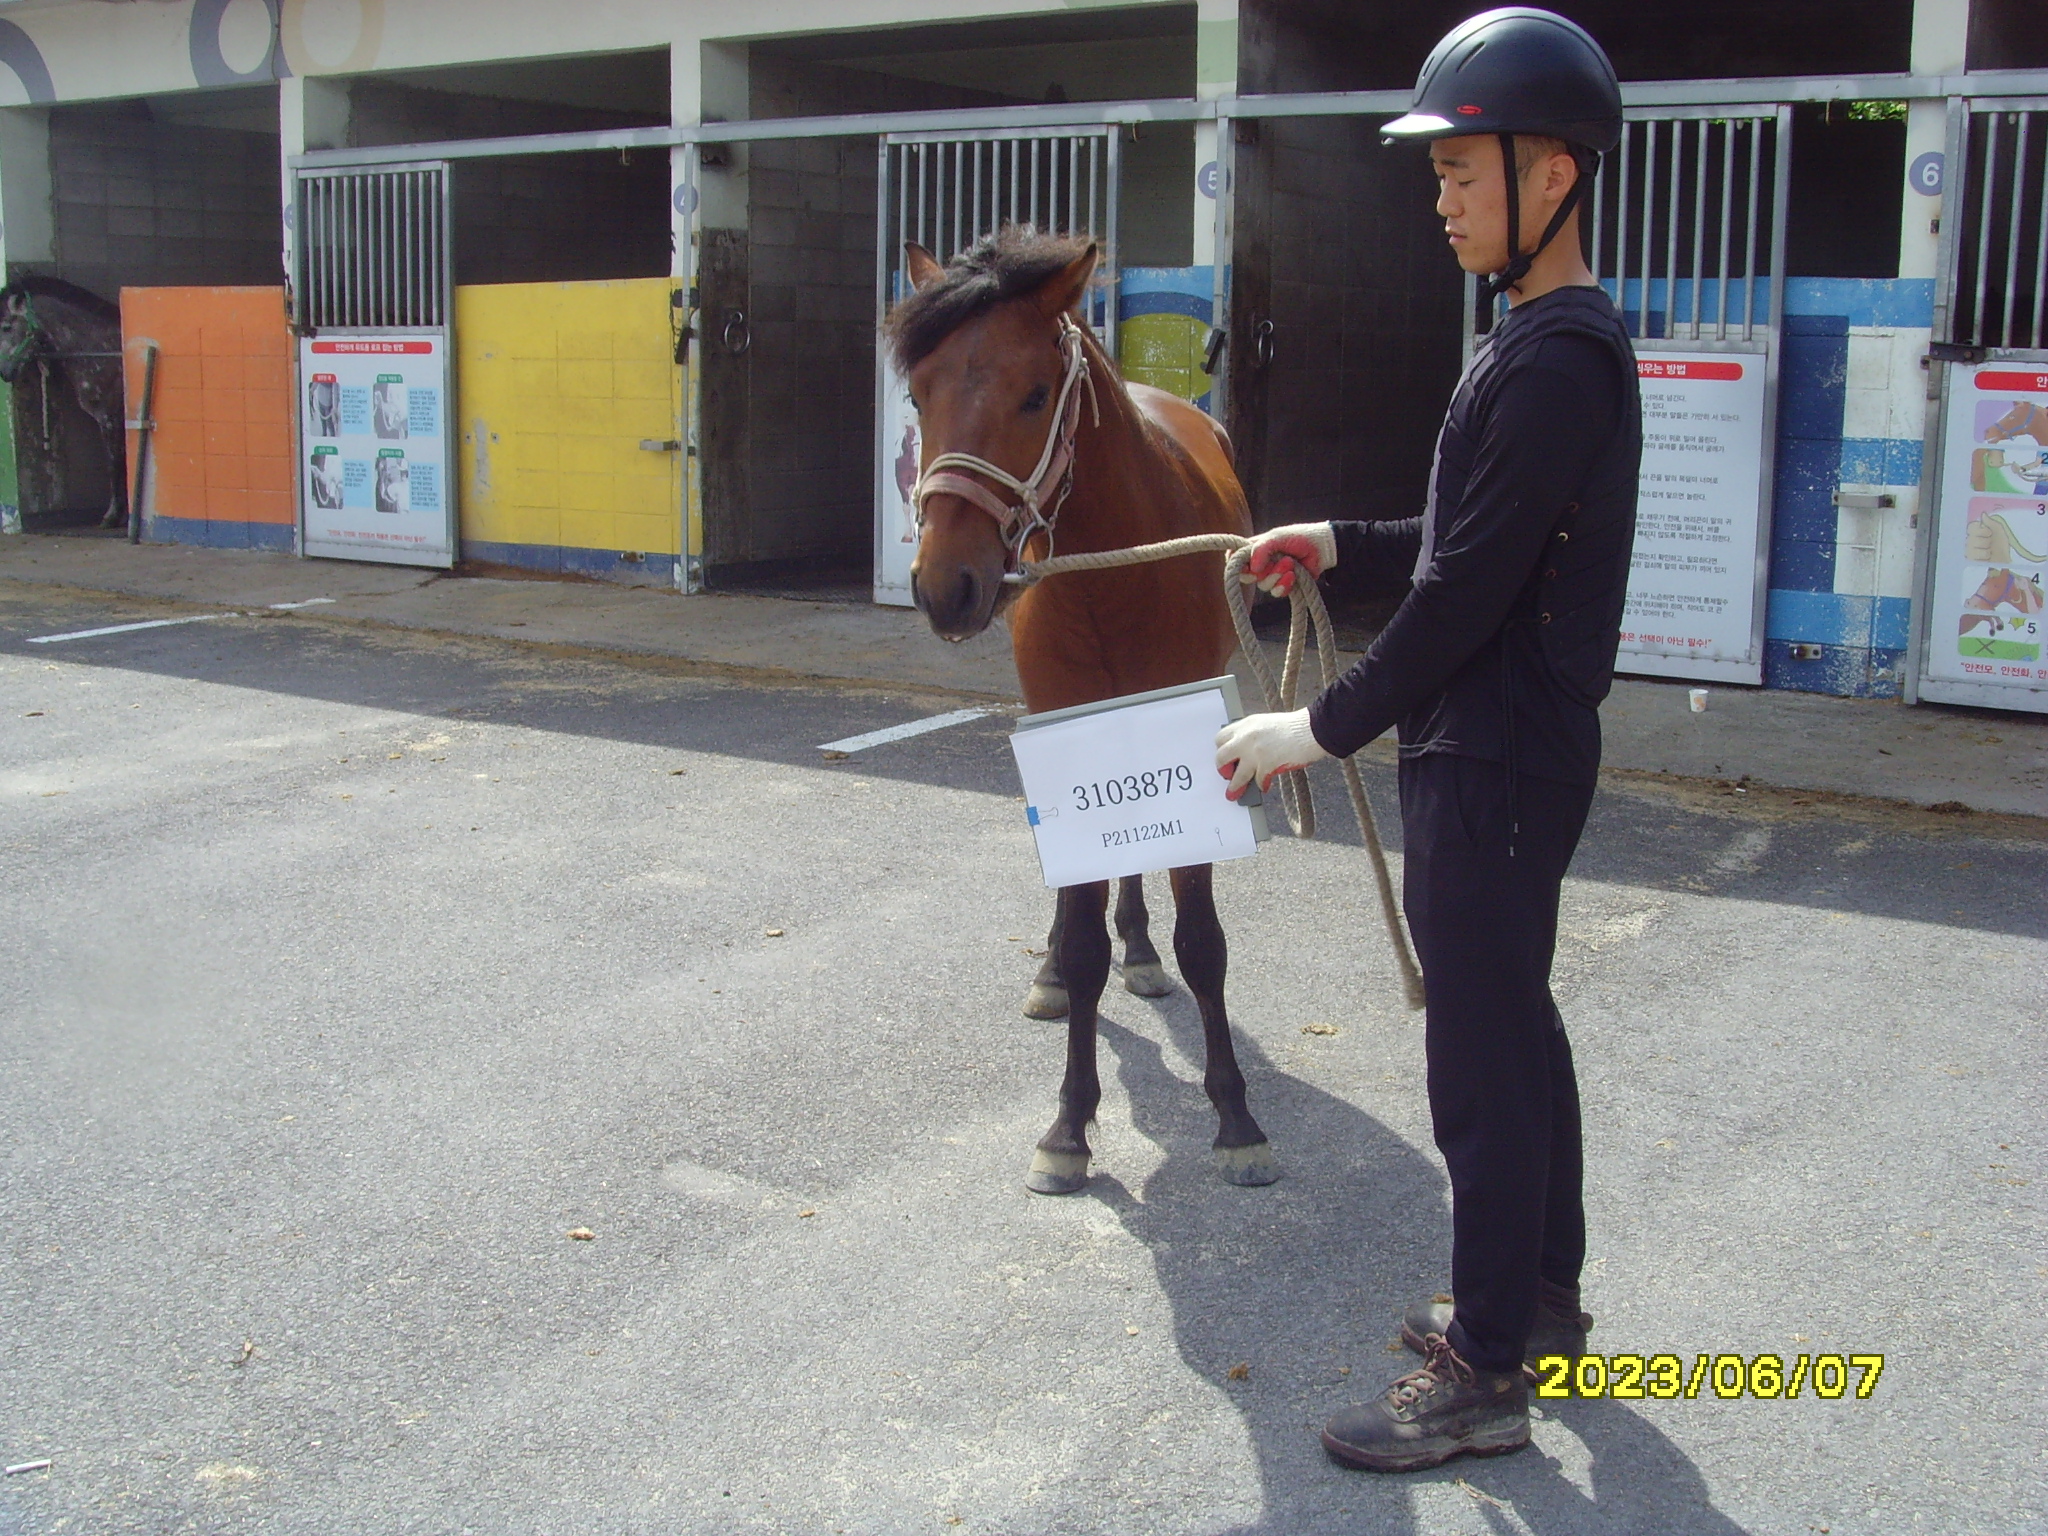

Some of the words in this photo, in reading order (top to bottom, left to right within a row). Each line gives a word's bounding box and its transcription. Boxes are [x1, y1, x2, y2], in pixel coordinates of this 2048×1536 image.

[1922, 162, 1940, 187] 6
[1666, 364, 1686, 375] 방법
[2041, 452, 2048, 465] 2
[2037, 503, 2046, 516] 3
[2031, 572, 2040, 585] 4
[2027, 622, 2036, 634] 5
[1639, 633, 1664, 645] 선택이
[1667, 635, 1684, 646] 아닌
[1072, 764, 1193, 811] 3103879
[1101, 819, 1184, 848] P21122M1
